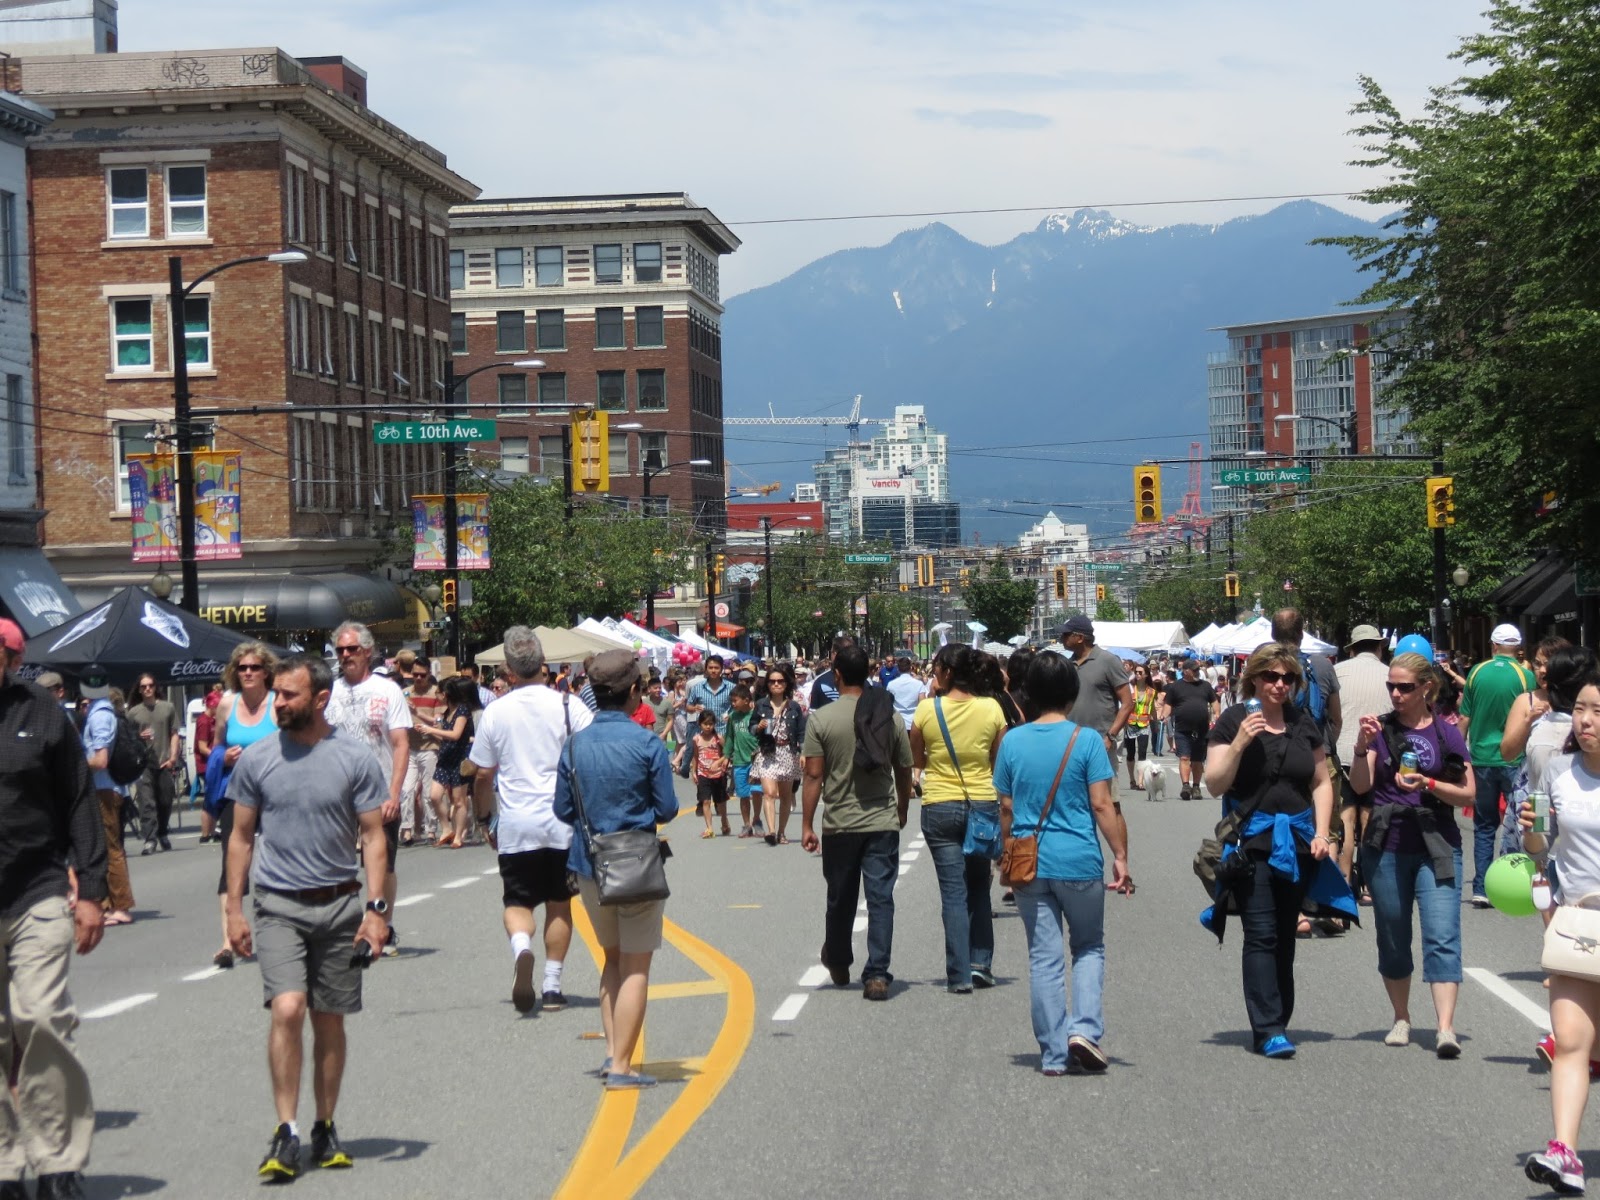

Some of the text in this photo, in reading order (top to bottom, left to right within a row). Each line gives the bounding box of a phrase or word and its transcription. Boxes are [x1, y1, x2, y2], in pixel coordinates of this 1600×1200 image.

[405, 424, 483, 439] E 10th Ave.
[1244, 470, 1301, 481] E 10th Ave.
[871, 480, 901, 489] Vancity
[855, 555, 888, 563] Broadway
